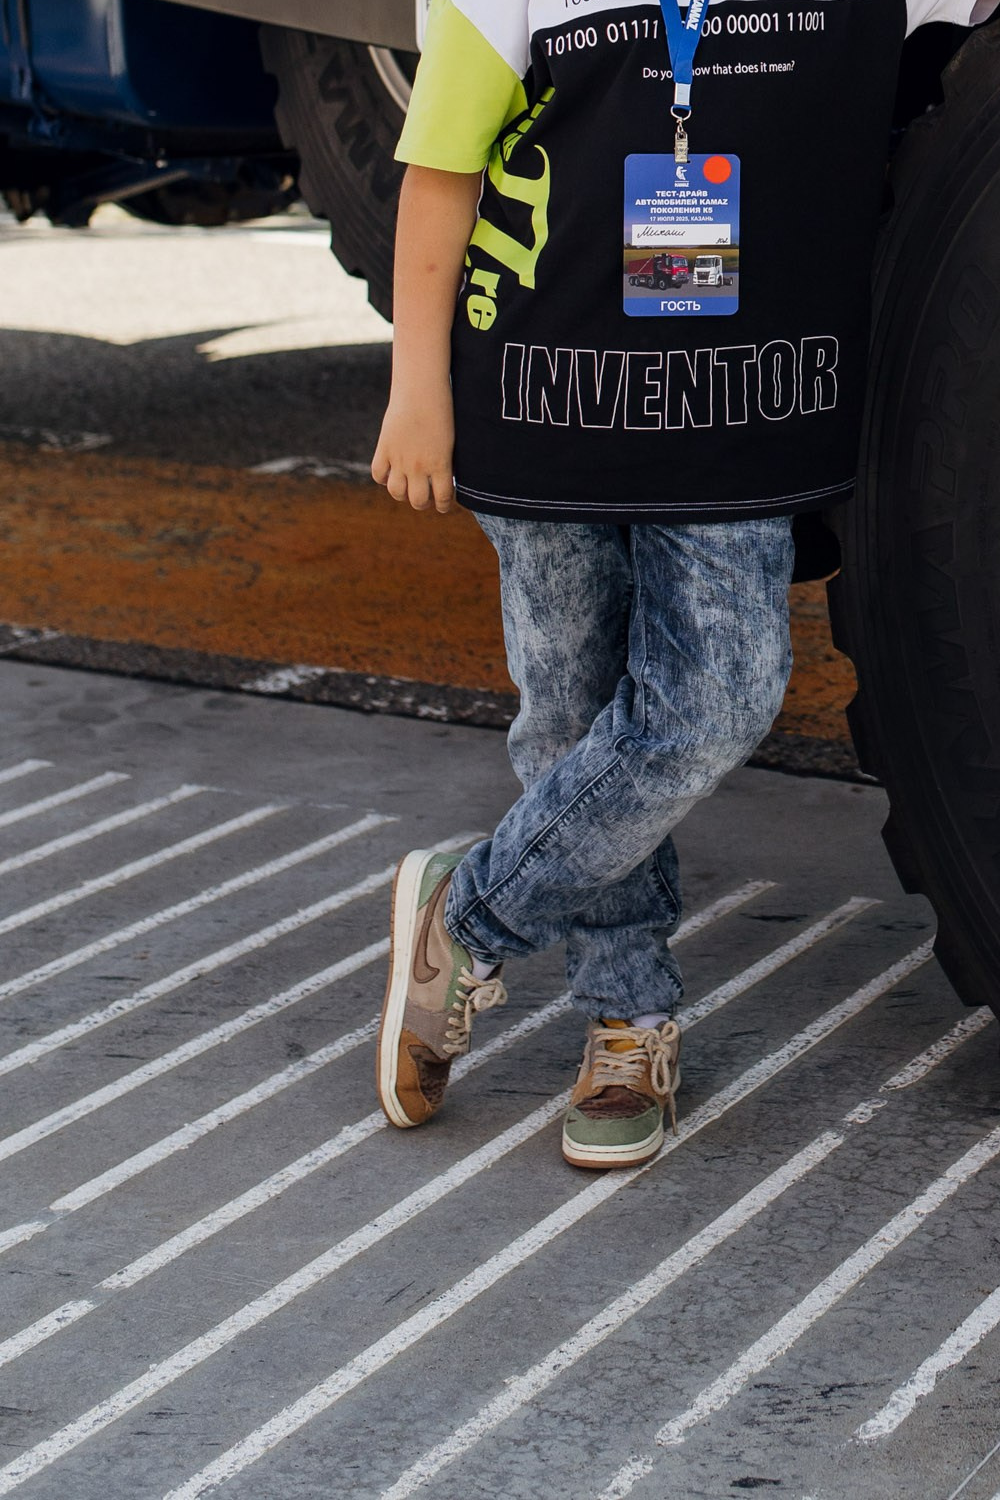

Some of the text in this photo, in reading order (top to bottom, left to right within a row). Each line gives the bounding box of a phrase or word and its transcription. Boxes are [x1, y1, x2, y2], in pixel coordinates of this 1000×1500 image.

[545, 27, 598, 56] 10100
[606, 18, 659, 44] 01111
[726, 12, 779, 35] 00001
[787, 11, 825, 32] 11001
[643, 67, 658, 79] Do
[661, 69, 673, 81] yo
[713, 63, 732, 75] that
[734, 62, 759, 74] does
[760, 62, 768, 73] it
[769, 60, 795, 73] mean?
[656, 190, 708, 198] ТЕСТ-ДРАЙВ
[635, 198, 728, 206] АВТОМОБИЛЕЙ KAMAZ
[650, 206, 701, 214] ПОКОЛЕНИЯ
[660, 300, 701, 311] ГОСТЬ
[501, 336, 839, 429] INVENTOR
